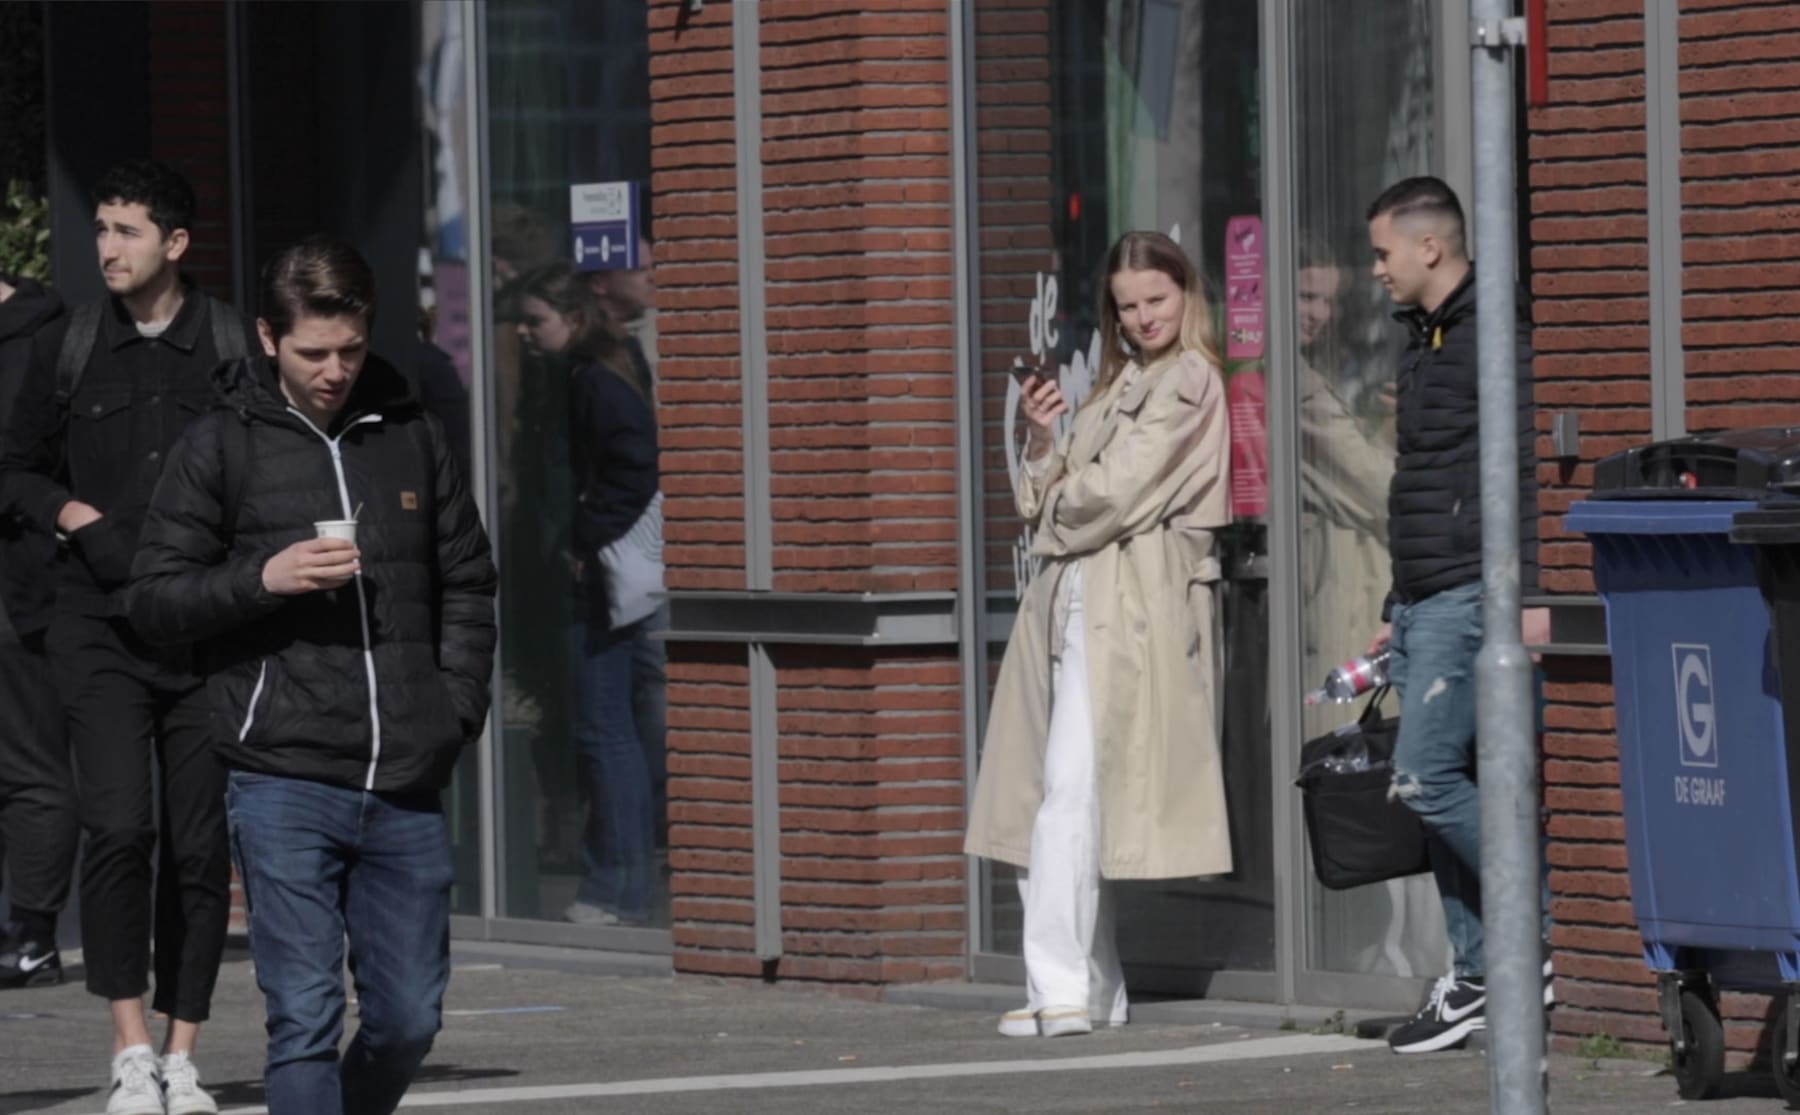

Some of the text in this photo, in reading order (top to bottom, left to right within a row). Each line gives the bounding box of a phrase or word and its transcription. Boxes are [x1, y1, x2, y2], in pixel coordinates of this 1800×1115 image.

[1029, 271, 1059, 356] de
[1679, 653, 1714, 757] G
[1674, 776, 1726, 806] DE GRAAF
